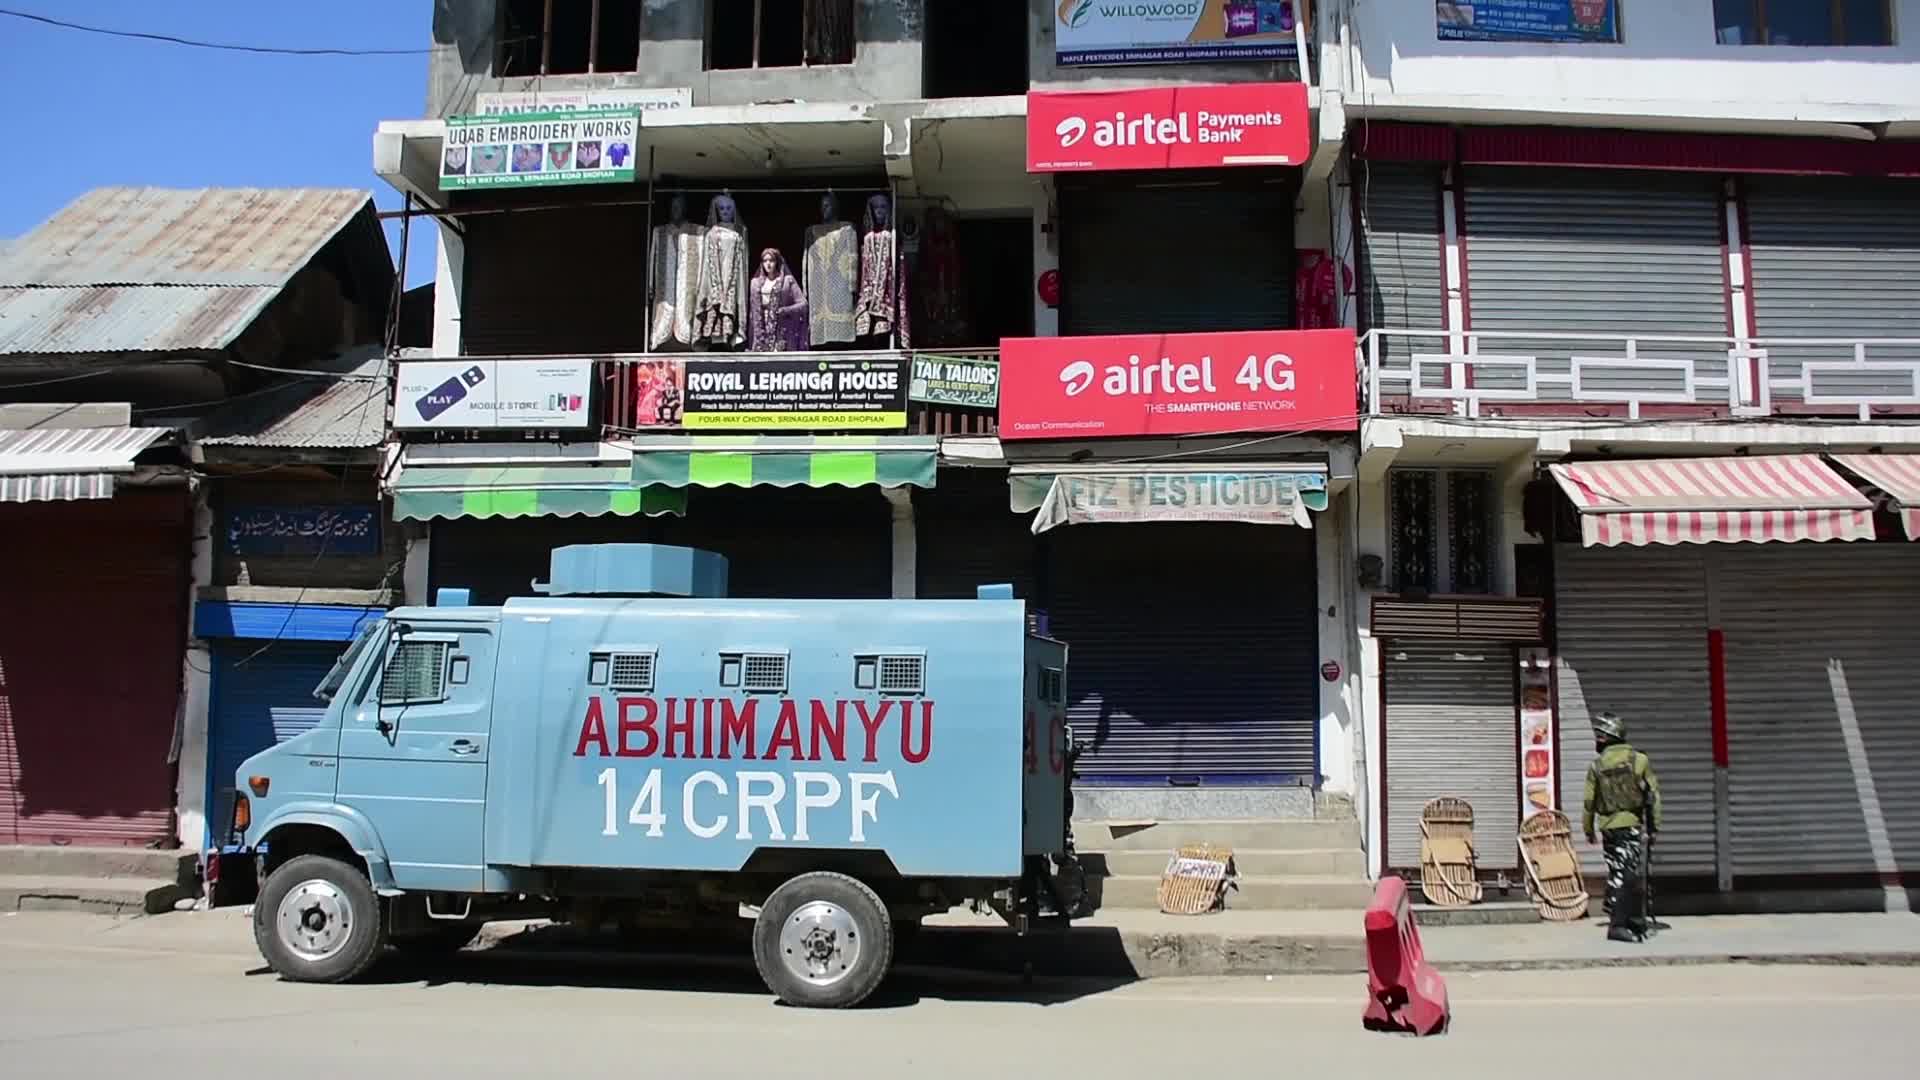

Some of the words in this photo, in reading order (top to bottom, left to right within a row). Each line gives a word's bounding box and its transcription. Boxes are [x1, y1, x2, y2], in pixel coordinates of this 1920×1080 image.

[1099, 3, 1197, 18] WILLOWOOD
[1198, 111, 1282, 128] Payments
[449, 127, 484, 145] UQAB
[489, 123, 578, 142] EMBROIDERY
[583, 120, 632, 137] WORKS
[1093, 112, 1191, 148] airtel
[1198, 128, 1242, 144] Bank
[687, 372, 744, 392] ROYAL
[749, 372, 833, 392] LEHANGA
[838, 371, 898, 391] HOUSE
[916, 361, 942, 380] TAK
[945, 364, 996, 385] TAILORS
[1102, 354, 1217, 397] airtel
[1235, 353, 1296, 392] 4G
[427, 395, 452, 405] PLAY
[470, 402, 503, 410] MOBILE
[507, 401, 538, 410] STORE
[1144, 403, 1166, 414] THE
[1167, 401, 1242, 413] SMARTPHONE
[1243, 400, 1296, 411] NETWORK
[848, 415, 885, 423] SHOPIAN
[1014, 422, 1040, 431] Ocean
[1041, 420, 1104, 430] Communication
[572, 696, 935, 764] ABHIMANYU
[597, 767, 667, 838] 14
[682, 769, 900, 843] CRPF
